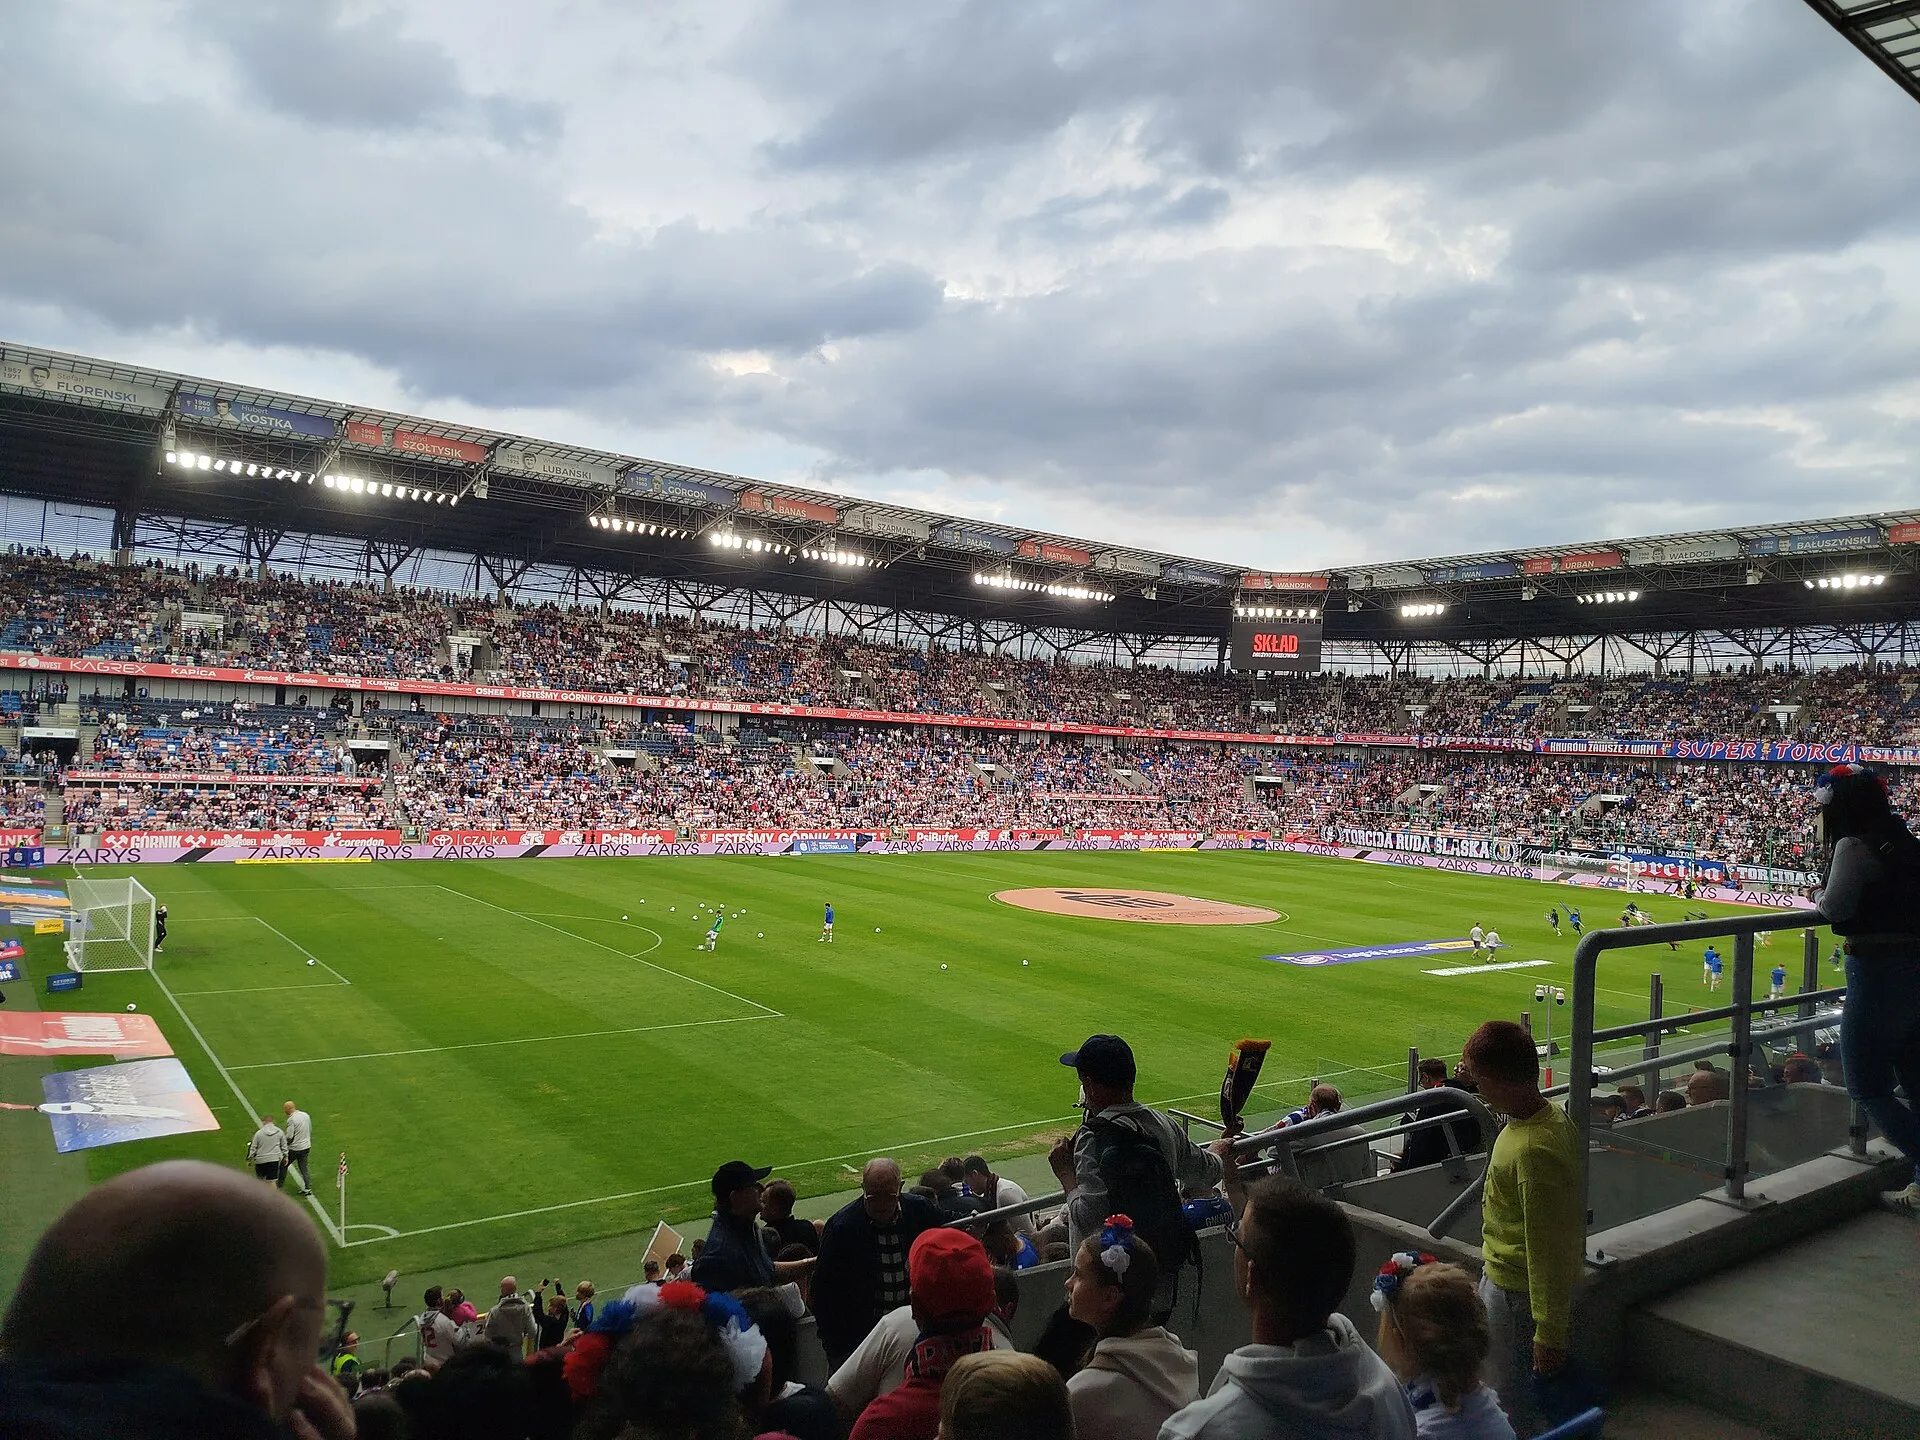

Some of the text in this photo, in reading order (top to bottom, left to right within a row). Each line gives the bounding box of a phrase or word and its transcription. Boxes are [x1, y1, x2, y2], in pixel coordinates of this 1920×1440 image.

[56, 372, 85, 383] Stefan
[56, 381, 137, 403] FLORENSKI
[241, 404, 268, 415] Hubert
[241, 412, 293, 430] KOSTKA
[402, 440, 462, 458] SZOŁTYSIK
[542, 465, 593, 480] LUBAŃSKI
[667, 486, 708, 500] GORGOŃ
[778, 506, 808, 518] BANAŚ
[877, 523, 917, 535] SZARMACH
[966, 538, 993, 550] PAŁASZ
[1796, 535, 1871, 550] BAŁUSZYŃSKI
[1046, 551, 1074, 562] MATYSIK
[1669, 549, 1716, 561] WAŁDOCH
[1119, 563, 1155, 575] DANKOWSKI
[1565, 560, 1595, 570] URBAN
[1461, 571, 1482, 579] IWAN
[1375, 578, 1398, 586] CYROŃ
[1253, 633, 1299, 653] SKŁAD
[70, 660, 147, 674] KAGREX
[366, 679, 399, 687] KUMHO
[475, 687, 505, 696] OSHEE
[516, 689, 627, 704] JESTEŚMY GÓRNIK ZABRZE
[636, 697, 662, 706] OSHEE
[1588, 743, 1623, 753] ZAWSZE
[1624, 744, 1630, 754] Z
[1631, 744, 1657, 755] WAMI
[1676, 740, 1857, 763] SUPER TORCA
[76, 771, 112, 779] STANLEY
[130, 832, 182, 848] GÓRNIK
[338, 837, 385, 847] corendon
[520, 831, 546, 845] STS
[558, 831, 583, 845] STS
[602, 833, 661, 844] PsiBufet
[708, 830, 774, 843] JESTEŚMY
[916, 832, 959, 841] PsiBufet
[1342, 829, 1393, 849] TORCIDA
[1396, 834, 1432, 853] RUDA
[57, 840, 1244, 863] ZARYS ZARYS ZARYS ZARYS ZARYS ZARYS ZARYS ZARYS ZARYS ZARYS ZARYS ZARYS ZARYS ZARYS
[1627, 846, 1652, 855] DAWID
[1264, 841, 1296, 851] ARYS
[1307, 844, 1340, 857] ZARYS
[1387, 852, 1425, 866] ZARYS
[1438, 858, 1478, 872] ZARYS
[1490, 865, 1533, 879] ZARYS
[1664, 883, 1717, 899] ZYS
[1735, 891, 1794, 908] ZARYS
[1737, 864, 1806, 886] TORCIDA
